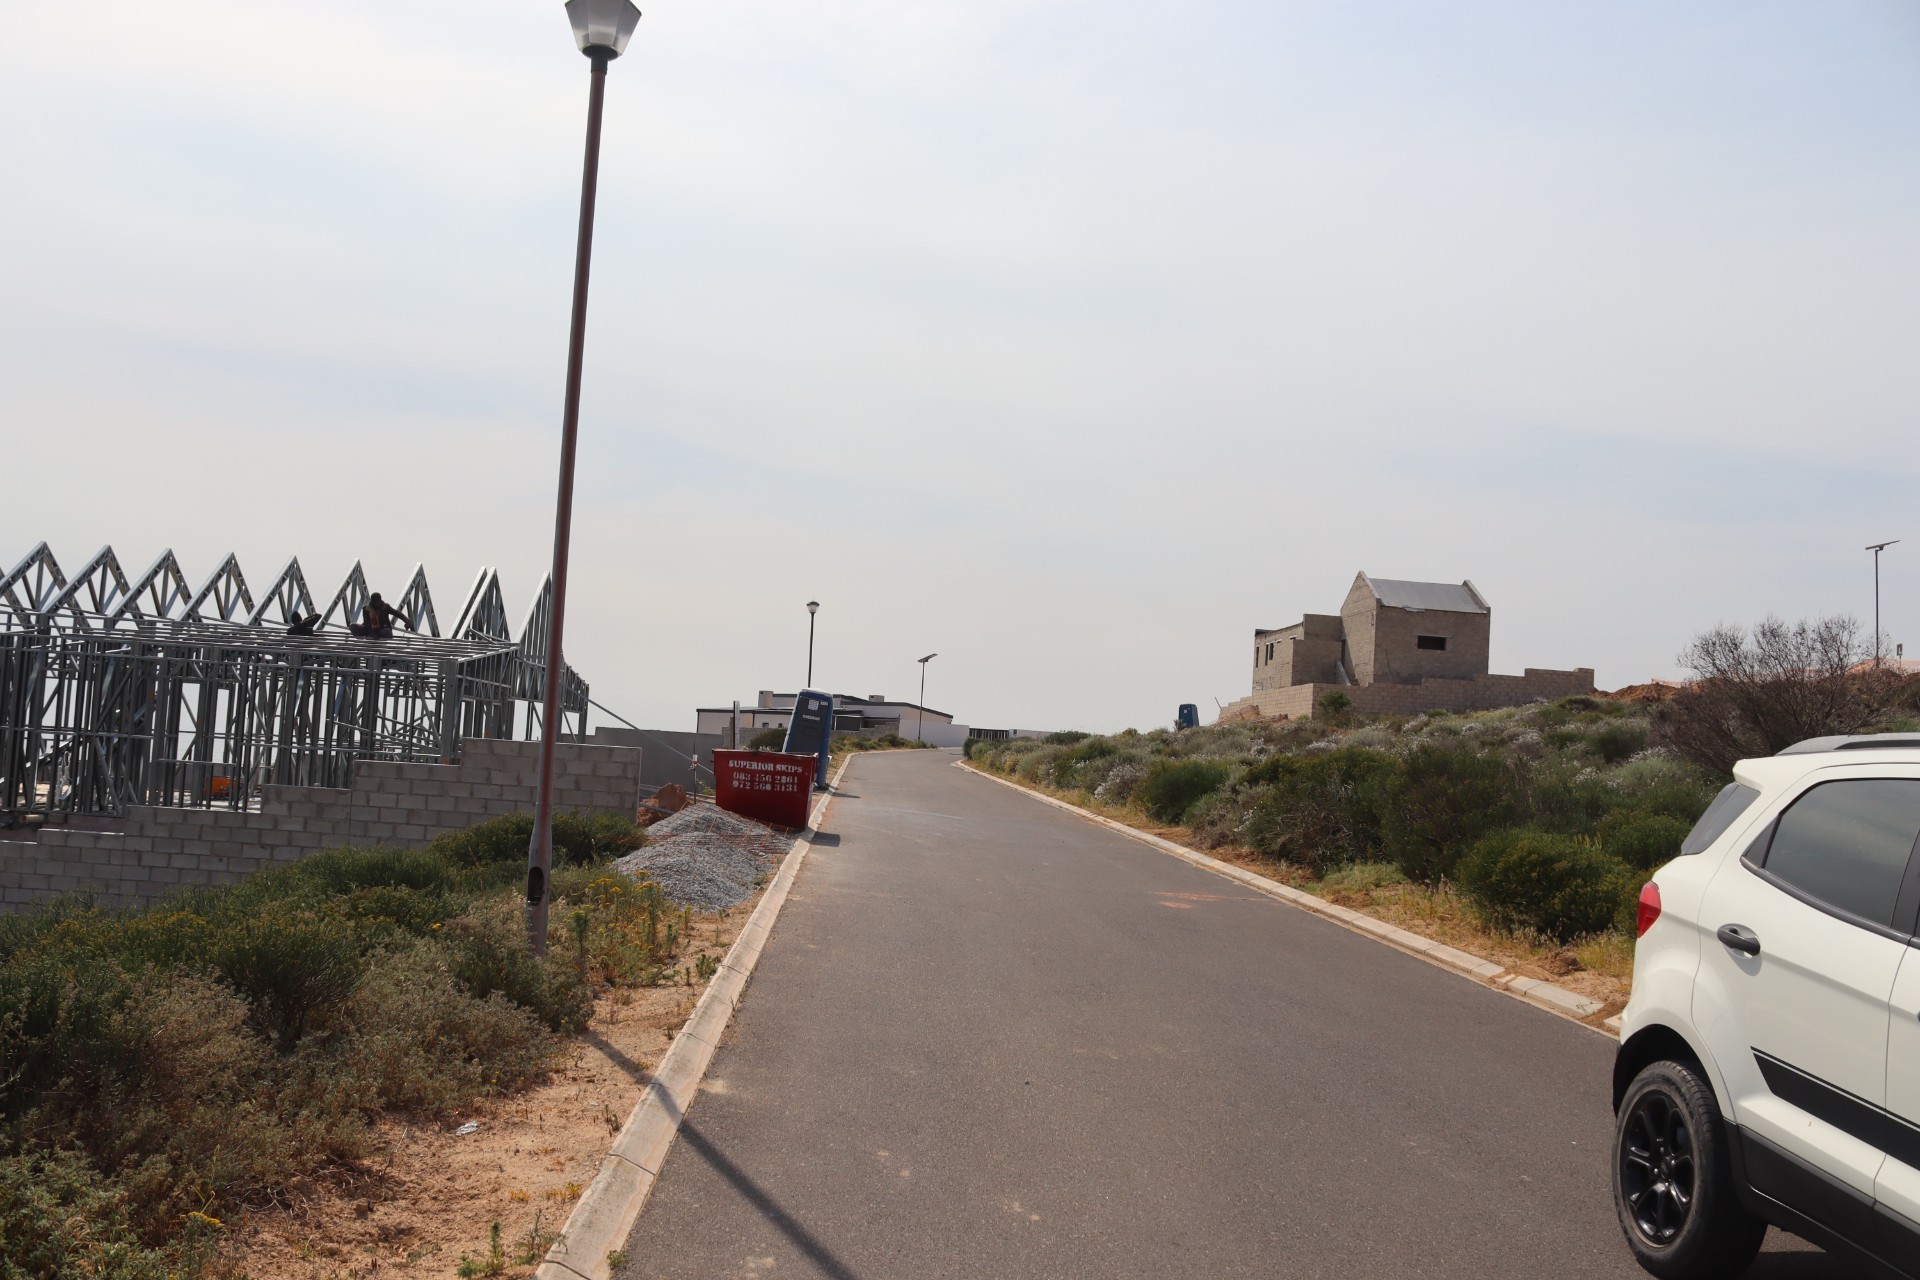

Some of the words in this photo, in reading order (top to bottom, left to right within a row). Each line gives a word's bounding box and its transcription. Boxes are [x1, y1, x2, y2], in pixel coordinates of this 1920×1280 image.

[728, 760, 774, 771] SUPERIOR
[776, 764, 803, 773] SKIPS
[733, 771, 751, 781] 083
[774, 775, 798, 784] 2861
[732, 780, 751, 789] 072
[753, 782, 772, 791] 560
[774, 784, 798, 792] 3131
